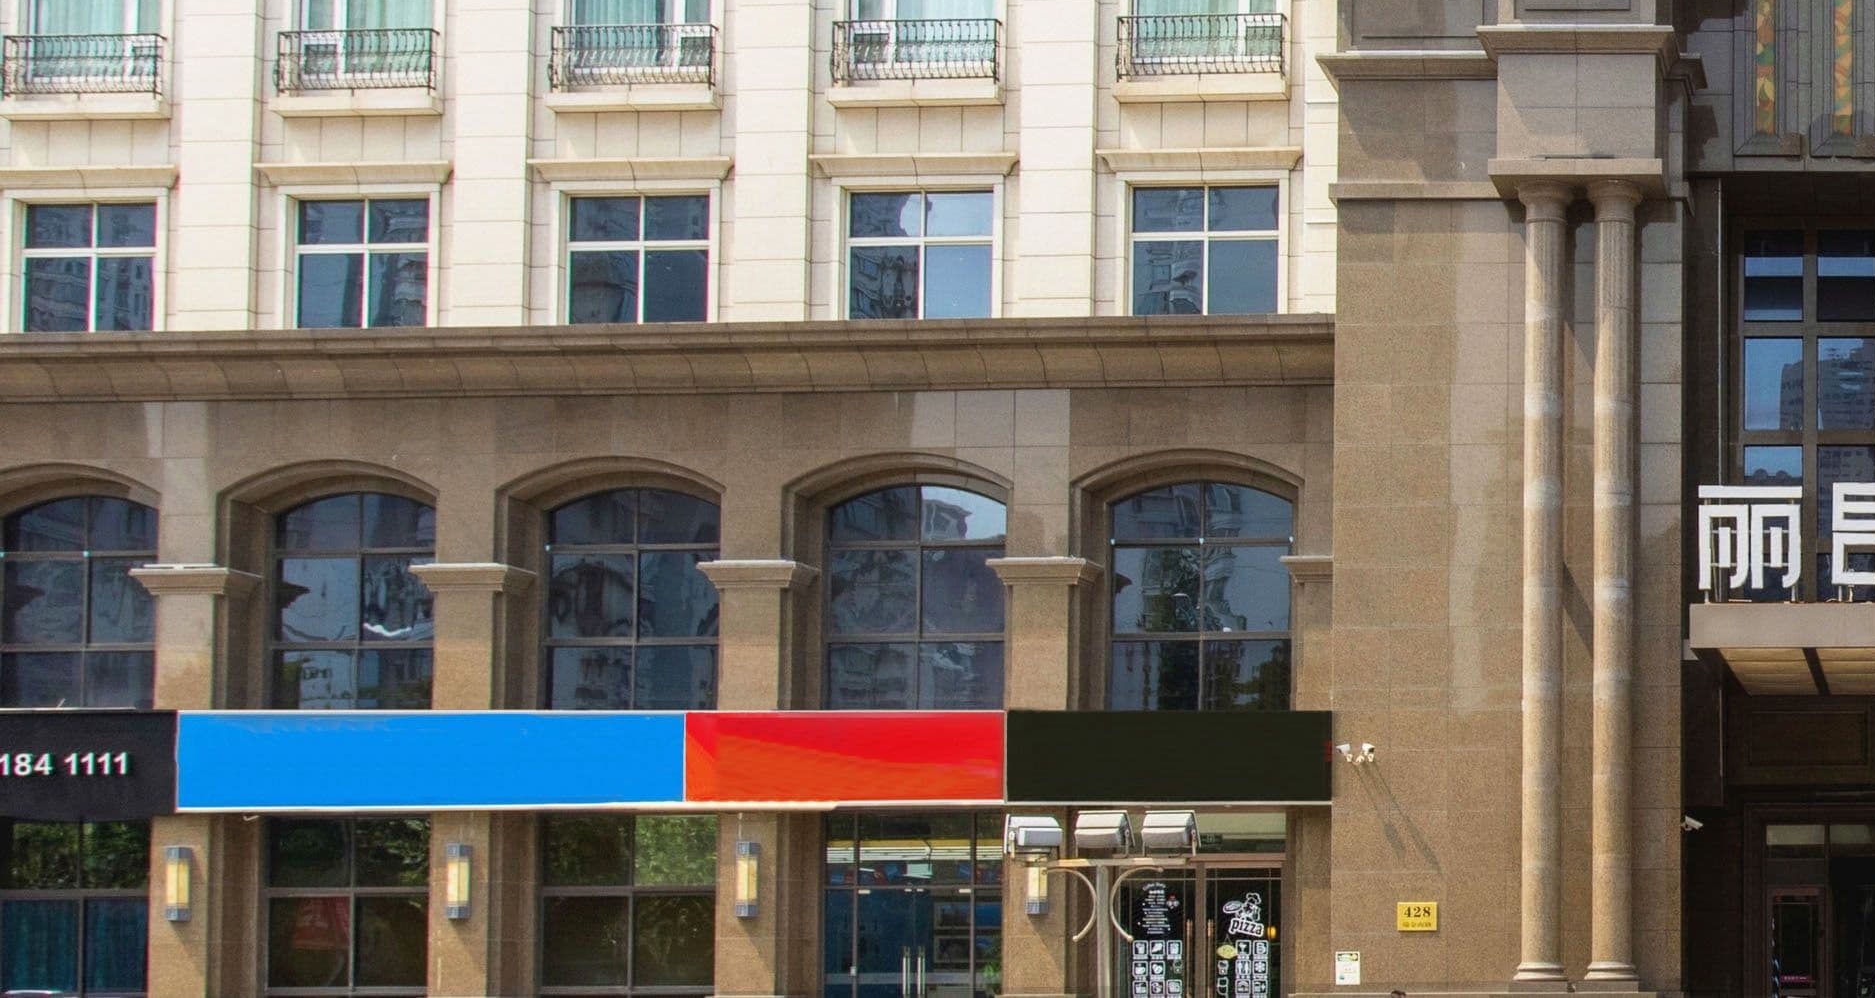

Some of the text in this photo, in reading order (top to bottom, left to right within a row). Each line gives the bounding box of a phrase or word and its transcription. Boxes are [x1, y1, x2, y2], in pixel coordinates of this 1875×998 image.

[0, 752, 128, 776] 184 1111
[1403, 906, 1431, 918] 428
[1230, 919, 1264, 936] pizza
